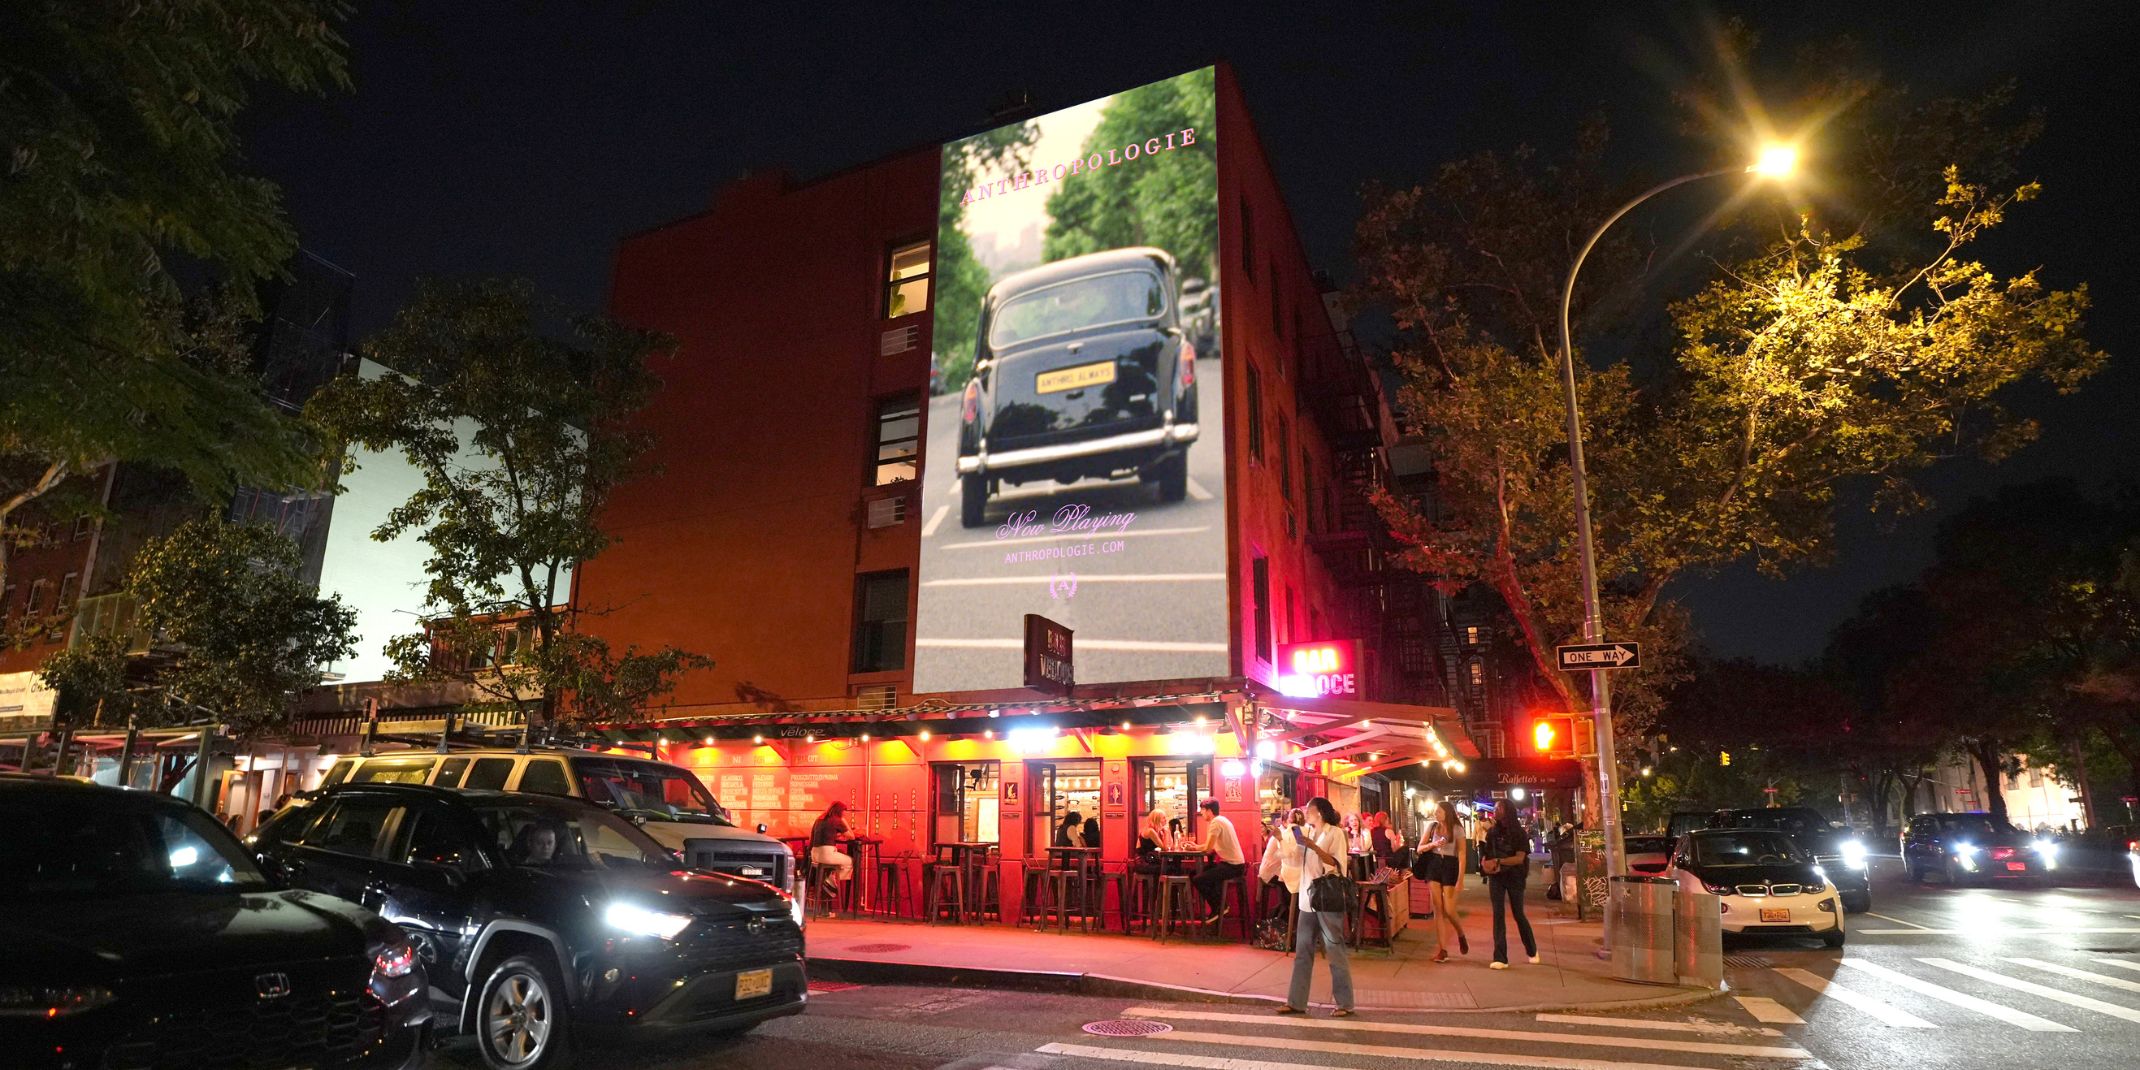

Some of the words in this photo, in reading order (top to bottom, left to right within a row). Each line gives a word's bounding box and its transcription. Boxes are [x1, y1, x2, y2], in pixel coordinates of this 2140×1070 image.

[959, 128, 1196, 207] ANTHROPOLOGIE
[1078, 367, 1111, 382] ALWAYS
[995, 509, 1046, 540] Now
[1050, 503, 1138, 540] Playing
[1004, 541, 1125, 565] ANTHROPOLOGIE.COM
[1294, 648, 1338, 672] BAR
[1569, 652, 1593, 662] ONE
[1602, 650, 1626, 661] WAY
[1498, 772, 1538, 785] Raffetto's
